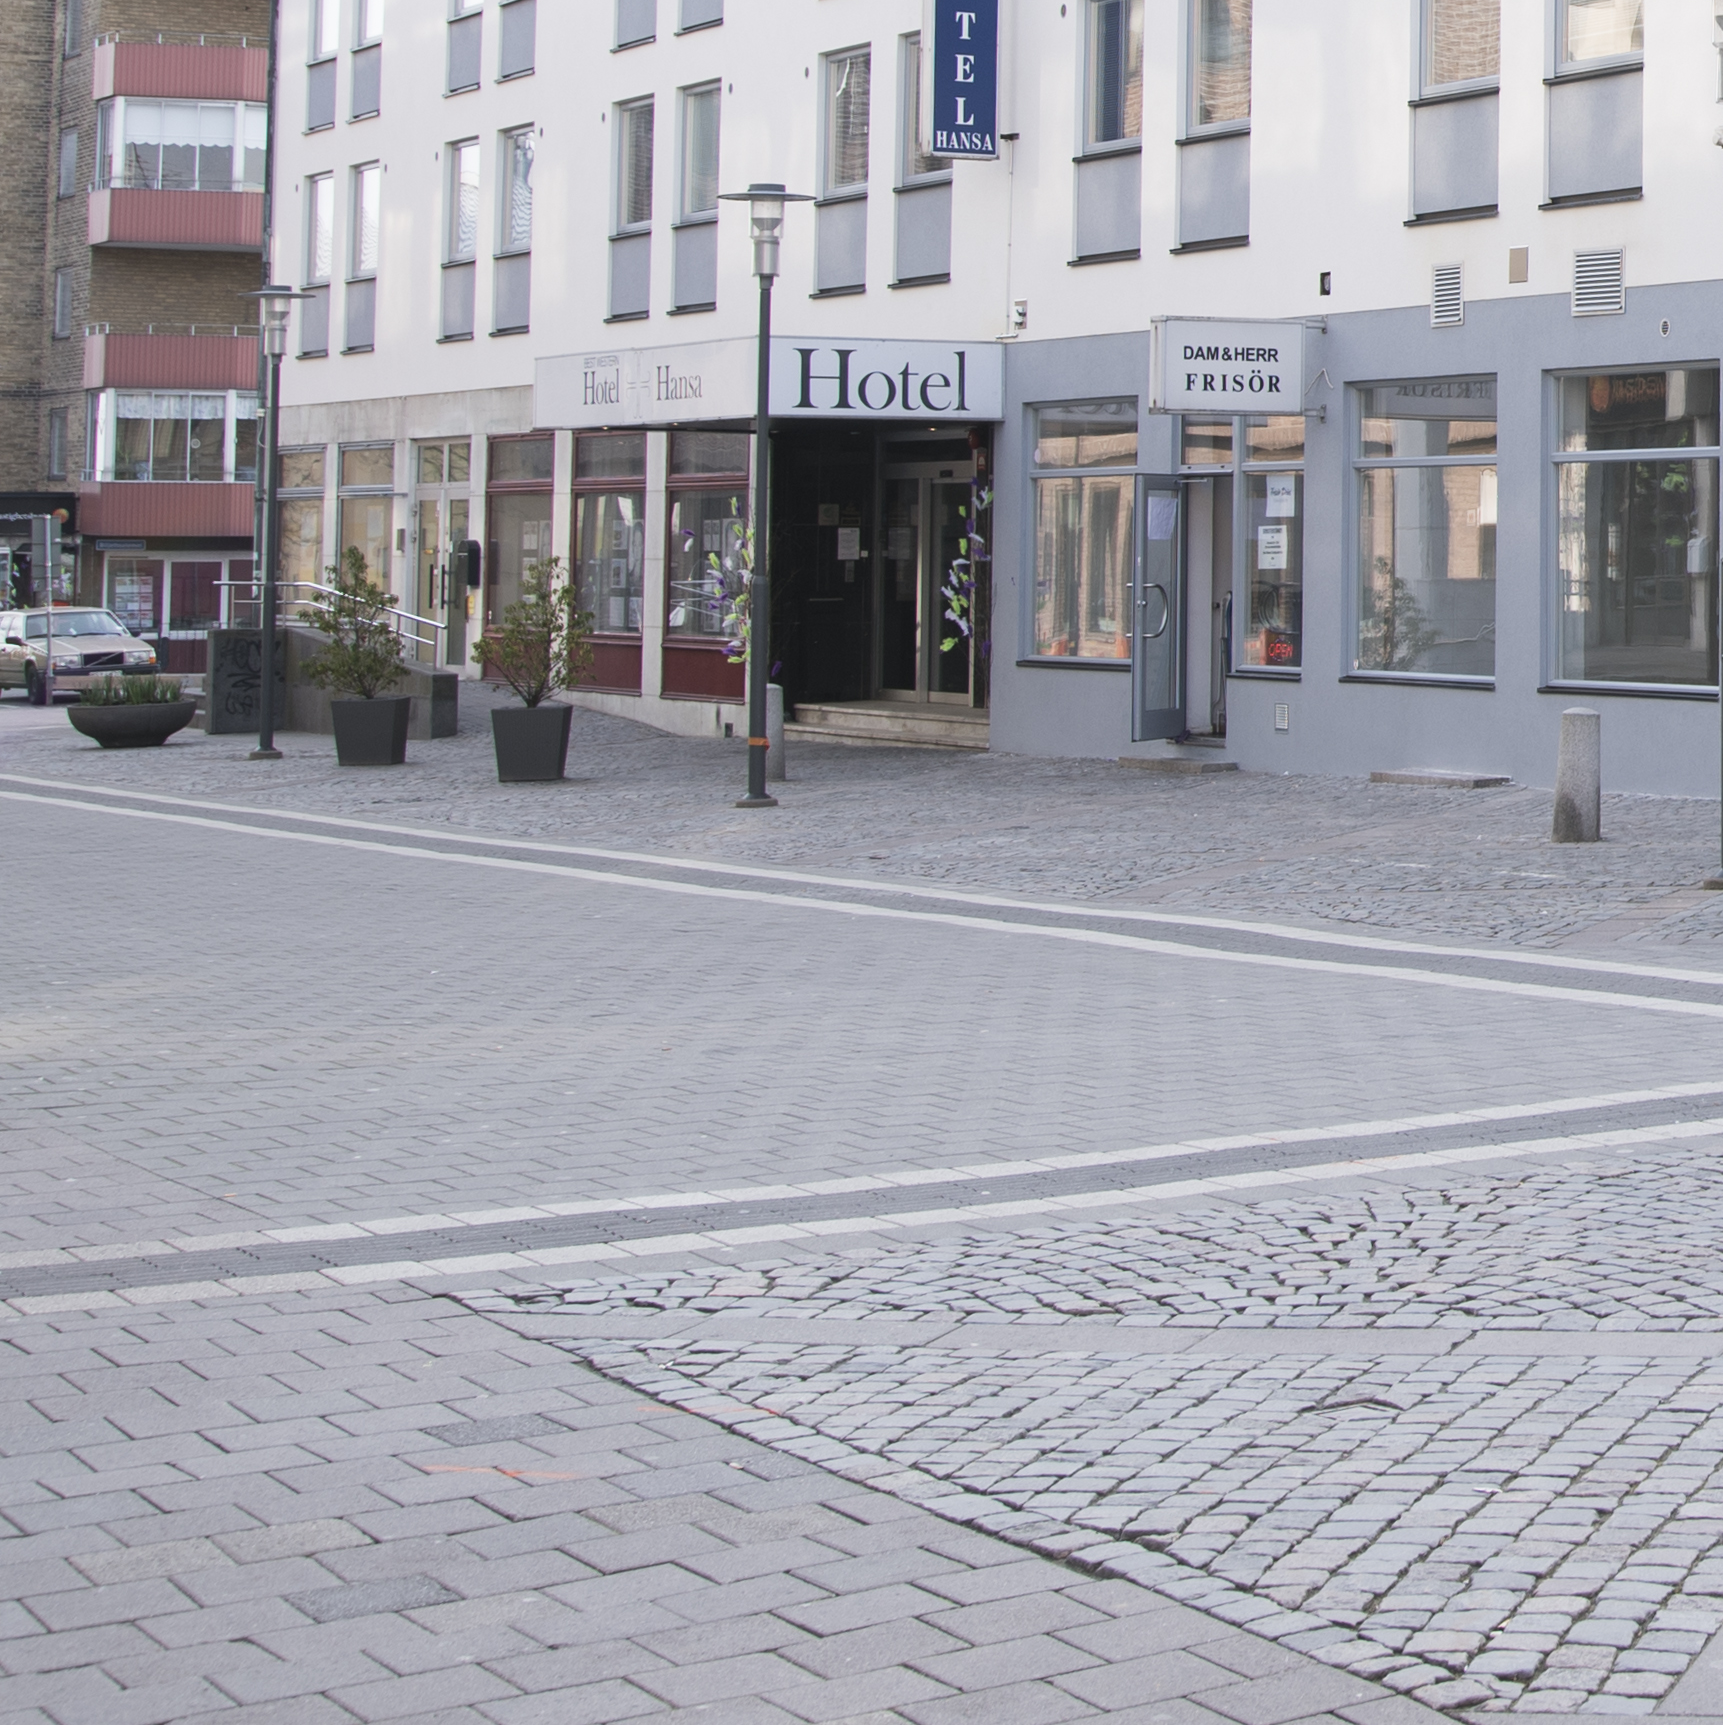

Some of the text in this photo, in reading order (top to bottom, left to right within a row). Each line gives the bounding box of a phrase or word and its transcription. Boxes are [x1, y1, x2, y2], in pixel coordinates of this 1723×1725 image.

[936, 130, 993, 151] HANSA
[583, 365, 703, 405] Hotel Hansa
[792, 348, 971, 412] Hotel
[1185, 369, 1281, 393] FRISÖR
